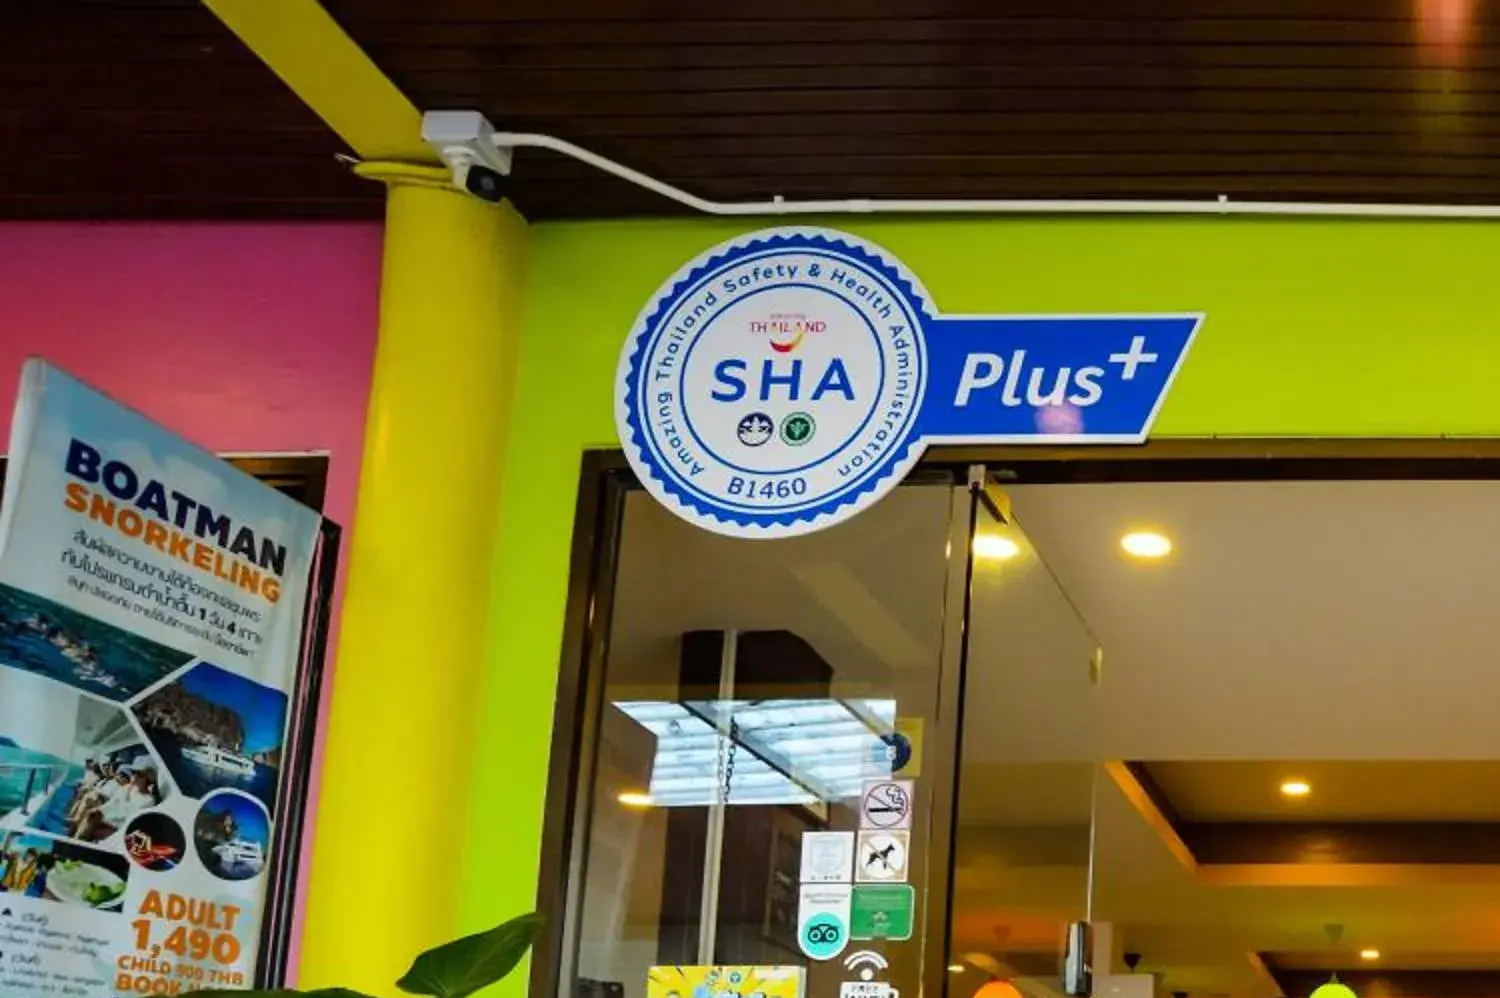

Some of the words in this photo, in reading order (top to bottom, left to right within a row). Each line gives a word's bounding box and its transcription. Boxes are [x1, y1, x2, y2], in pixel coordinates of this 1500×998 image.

[723, 263, 799, 293] Safety
[807, 263, 821, 278] &
[830, 267, 891, 319] Health
[655, 291, 717, 381] Thailand
[710, 356, 856, 402] SHA
[837, 325, 913, 478] Administration
[657, 391, 705, 477] Amazing
[64, 437, 287, 577] BOATMAN
[727, 476, 807, 499] B1460
[64, 481, 282, 605] SNORKELING
[199, 607, 207, 621] 1
[138, 889, 241, 931] ADULT
[131, 919, 241, 965] 1,490
[116, 973, 181, 995] BOOK
[117, 955, 171, 974] CHILD
[208, 969, 244, 985] THB
